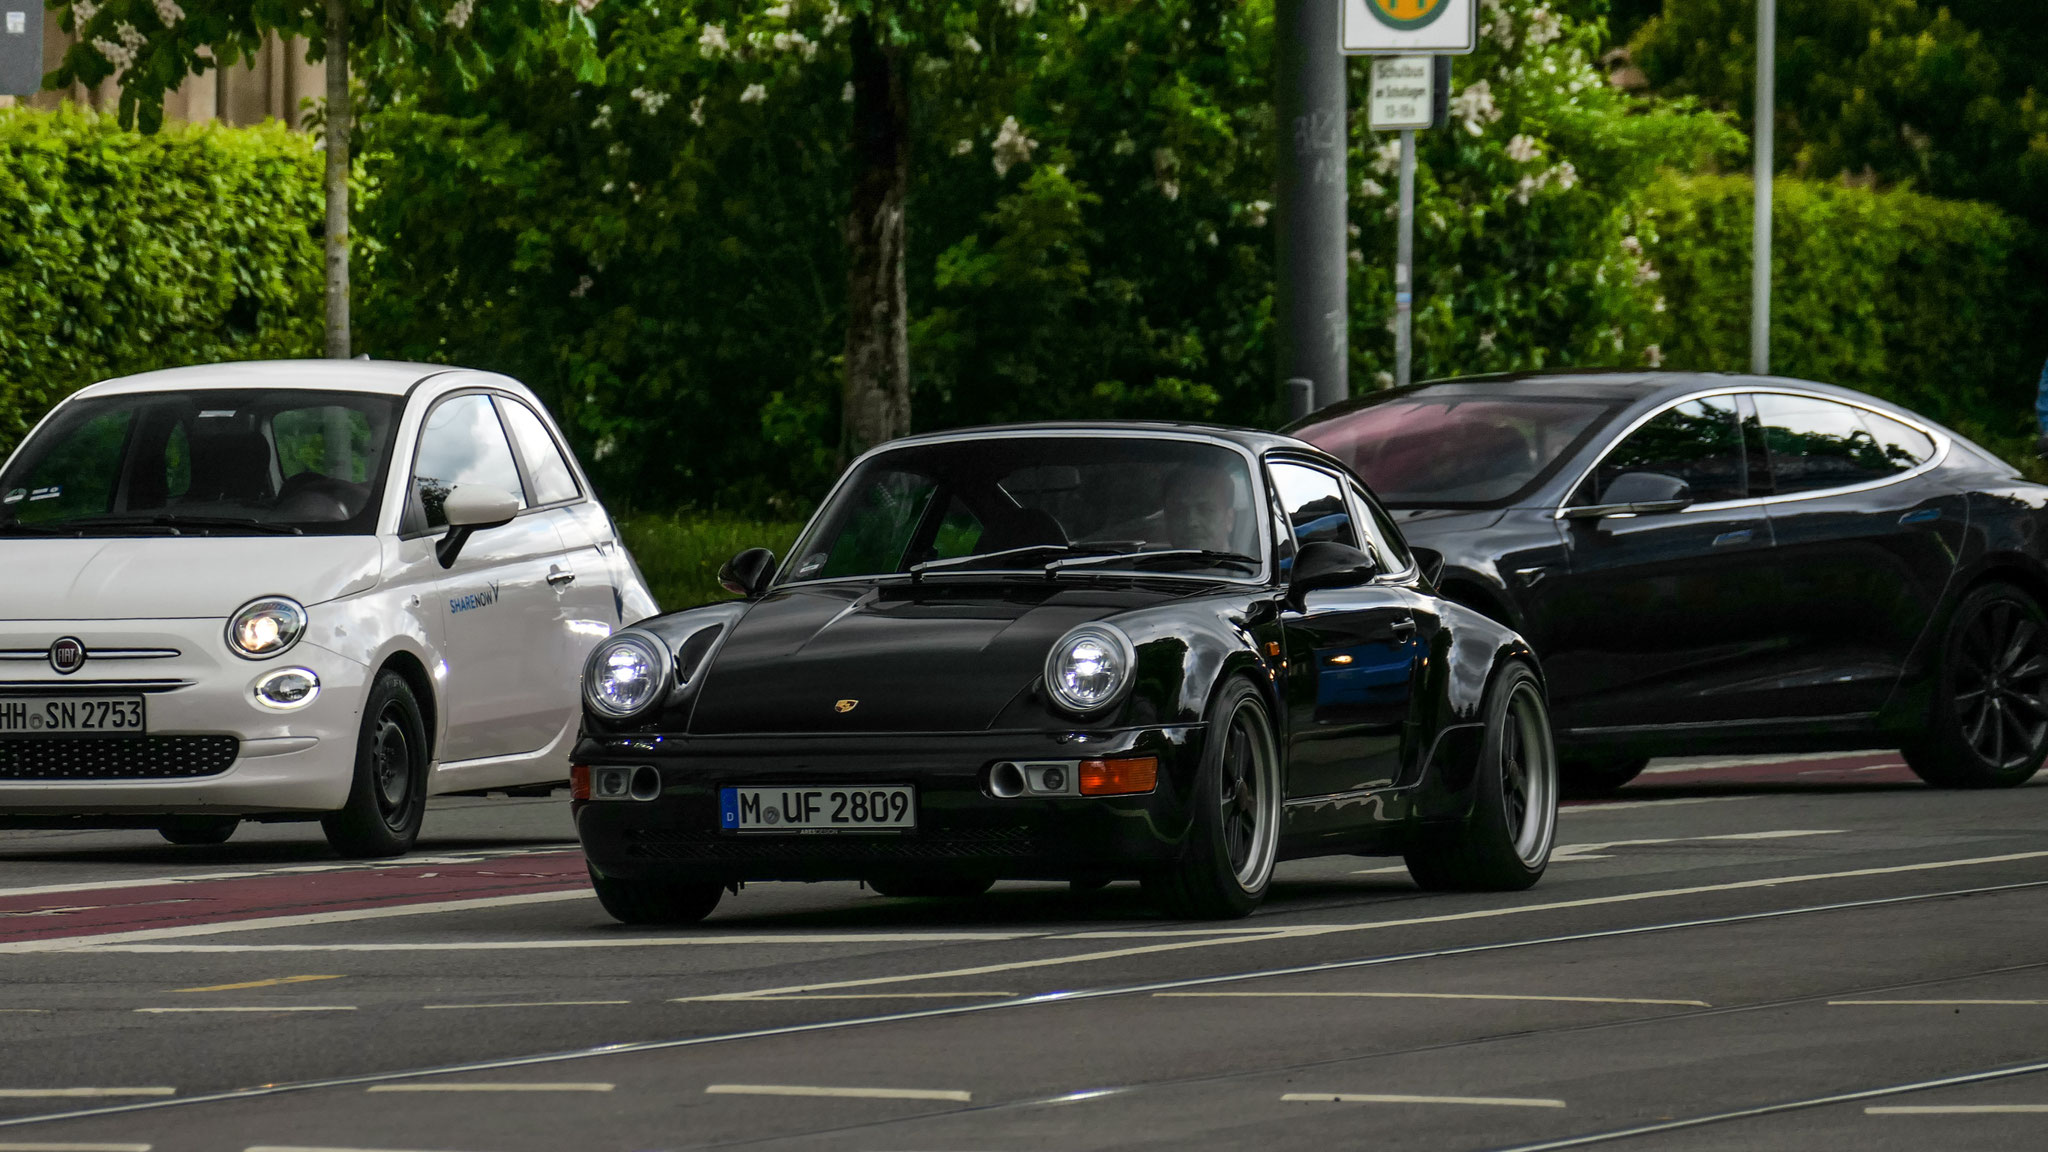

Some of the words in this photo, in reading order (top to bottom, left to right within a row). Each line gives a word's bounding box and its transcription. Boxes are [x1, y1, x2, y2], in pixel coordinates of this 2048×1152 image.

[449, 591, 493, 614] SHARENOW
[57, 648, 76, 663] FIAT
[0, 702, 27, 730] HH
[45, 702, 76, 729] SN
[81, 701, 141, 729] 2753
[726, 812, 734, 822] D
[740, 792, 761, 824] M
[782, 792, 823, 823] UF
[830, 791, 908, 823] 2809
